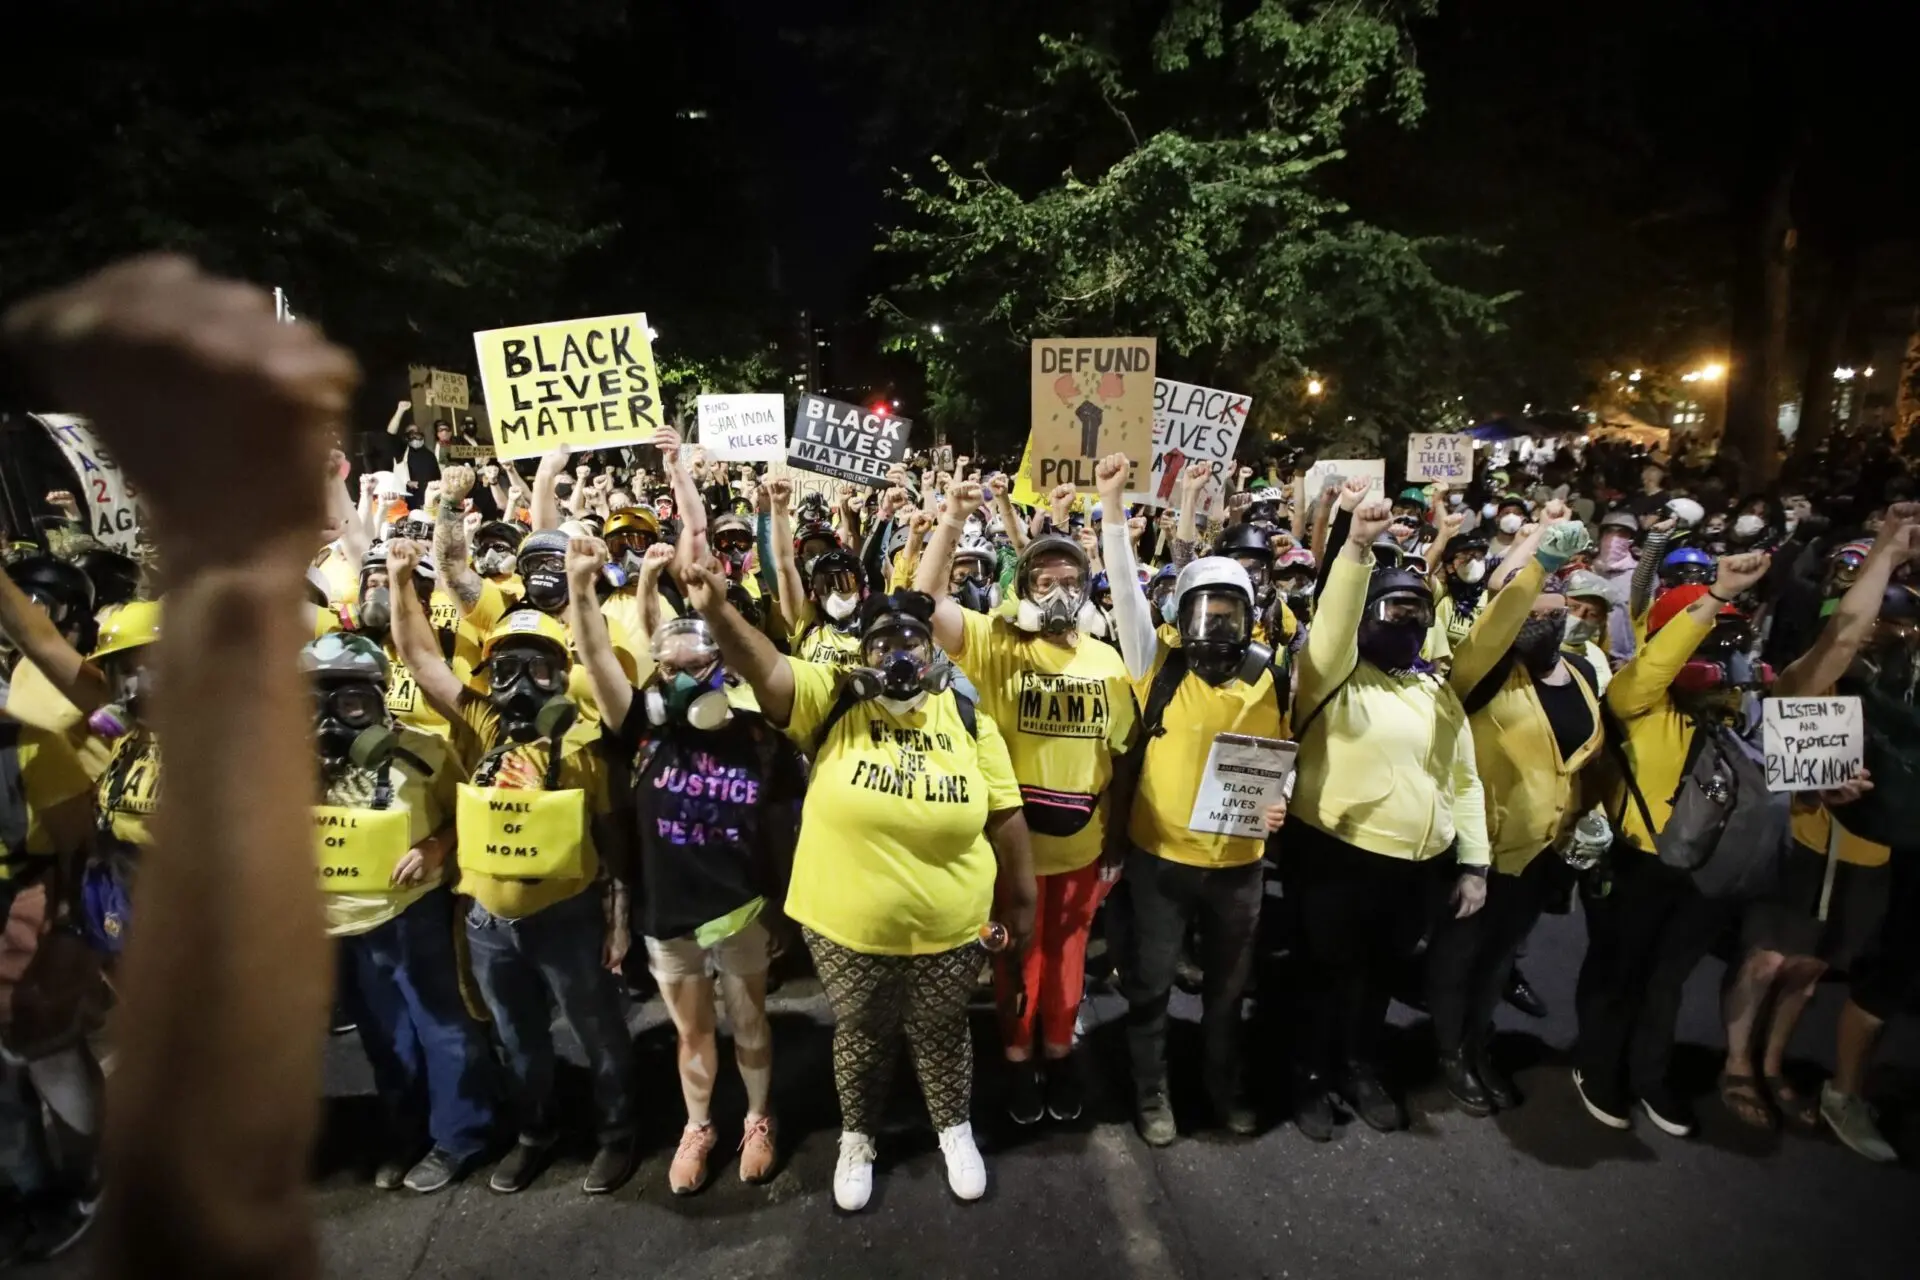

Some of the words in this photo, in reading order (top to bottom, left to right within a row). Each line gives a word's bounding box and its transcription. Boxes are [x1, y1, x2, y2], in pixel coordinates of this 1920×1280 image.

[503, 326, 637, 378] BLACK
[1041, 347, 1150, 373] DEFUND
[510, 365, 649, 411] LIVES
[704, 402, 729, 414] FIND
[1153, 381, 1247, 428] BLACK
[500, 394, 658, 444] MATTER
[741, 409, 775, 427] INDIA
[806, 398, 902, 440] BLACK
[728, 434, 778, 449] KILLERS
[806, 420, 893, 459] LIVES
[1152, 419, 1233, 458] IVES
[1424, 436, 1460, 450] SAY
[797, 442, 891, 480] MATTER
[1418, 451, 1465, 464] THEIR
[814, 465, 838, 477] SILENCE
[843, 471, 869, 484] VIOLENCE
[1041, 458, 1139, 490] POLIE
[1421, 463, 1464, 477] NAMES
[1026, 674, 1102, 696] SUMMONED
[1023, 690, 1104, 724] MAMA
[1778, 699, 1828, 719] LISTEN
[1832, 702, 1846, 716] TO
[1022, 719, 1104, 735] #BLACKLIVESMATTER
[1799, 721, 1818, 731] AND
[894, 728, 933, 752] BEEN
[936, 733, 954, 753] ON
[1784, 734, 1849, 753] PROTECT
[898, 748, 926, 772] THE
[1766, 754, 1818, 786] BLACK
[1821, 756, 1860, 785] MOMS
[653, 766, 759, 804] JUSTICE
[850, 760, 916, 799] FRONT
[925, 774, 970, 803] LINE
[1223, 782, 1265, 796] BLACK
[489, 800, 532, 813] WALL
[1222, 798, 1256, 809] LIVES
[1209, 811, 1259, 825] MATTER
[503, 823, 523, 834] OF
[325, 837, 345, 848] OF
[486, 844, 538, 857] MOMS
